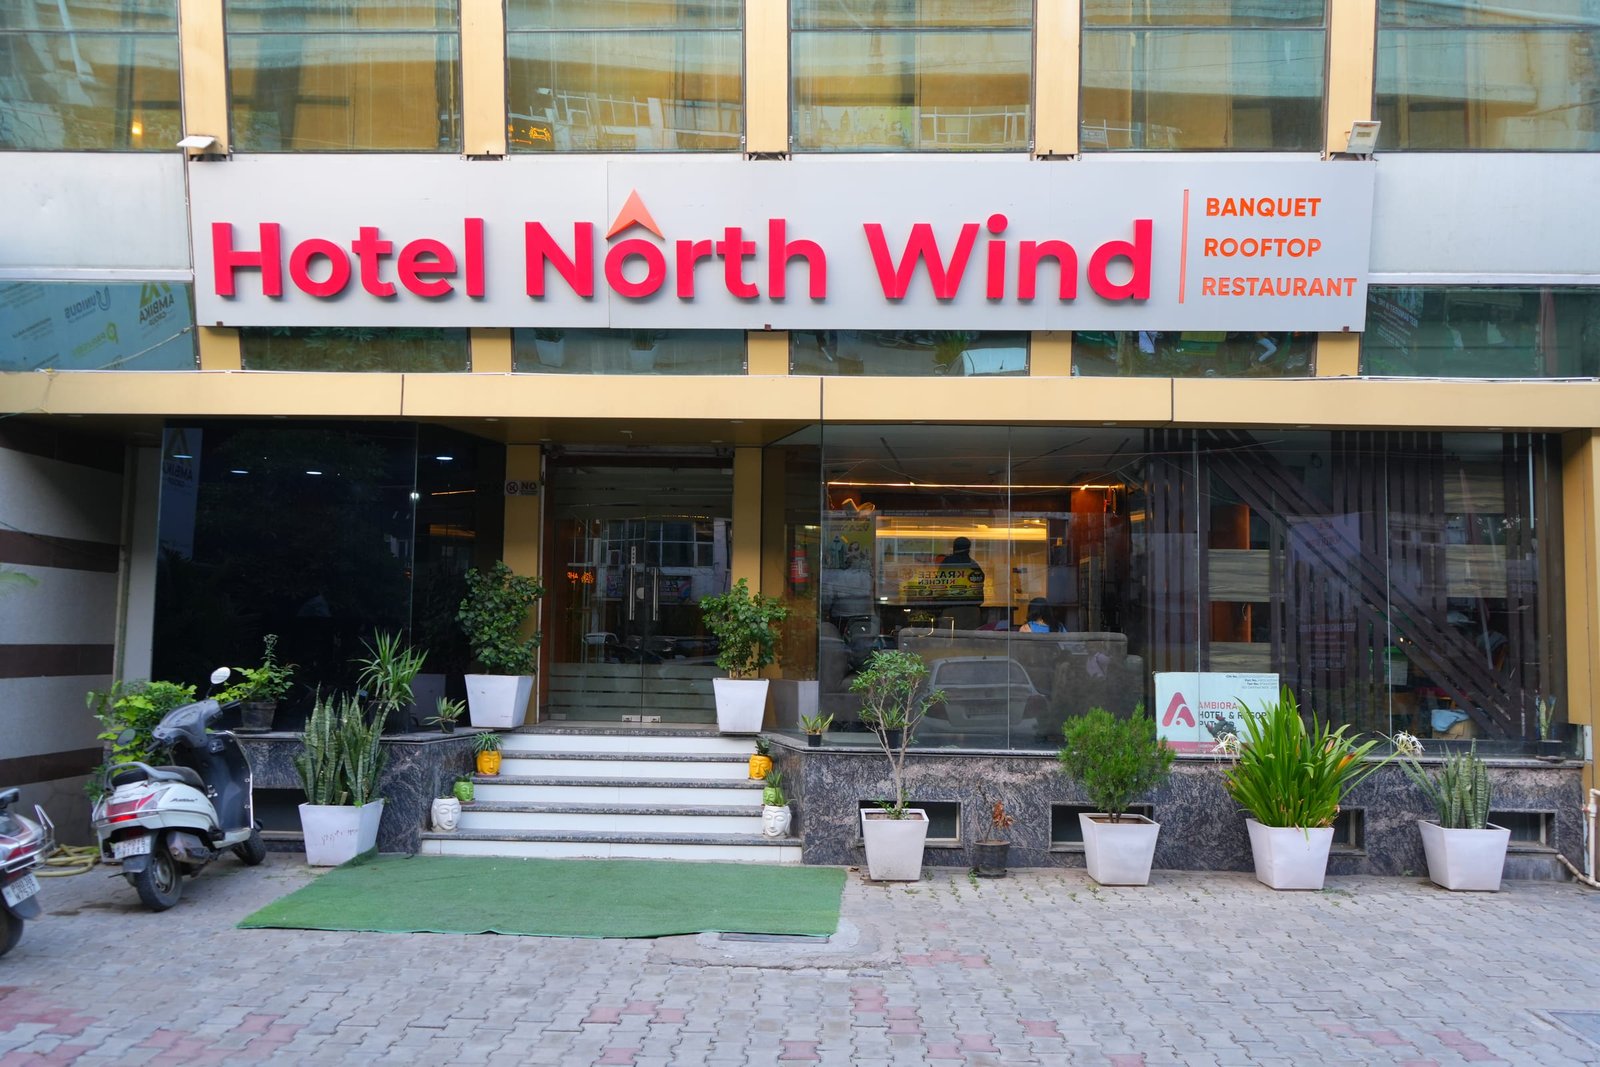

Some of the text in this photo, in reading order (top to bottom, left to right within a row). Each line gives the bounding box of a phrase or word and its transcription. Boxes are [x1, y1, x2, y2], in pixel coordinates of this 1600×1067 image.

[1206, 197, 1321, 218] BANQUET
[211, 216, 484, 299] Hotel
[863, 213, 1153, 303] Wind
[1204, 238, 1321, 258] ROOFTOP
[1202, 277, 1356, 297] RESTAURANT
[521, 481, 538, 490] NO
[1199, 701, 1238, 710] AMBIORA
[1199, 711, 1224, 720] HOTEL
